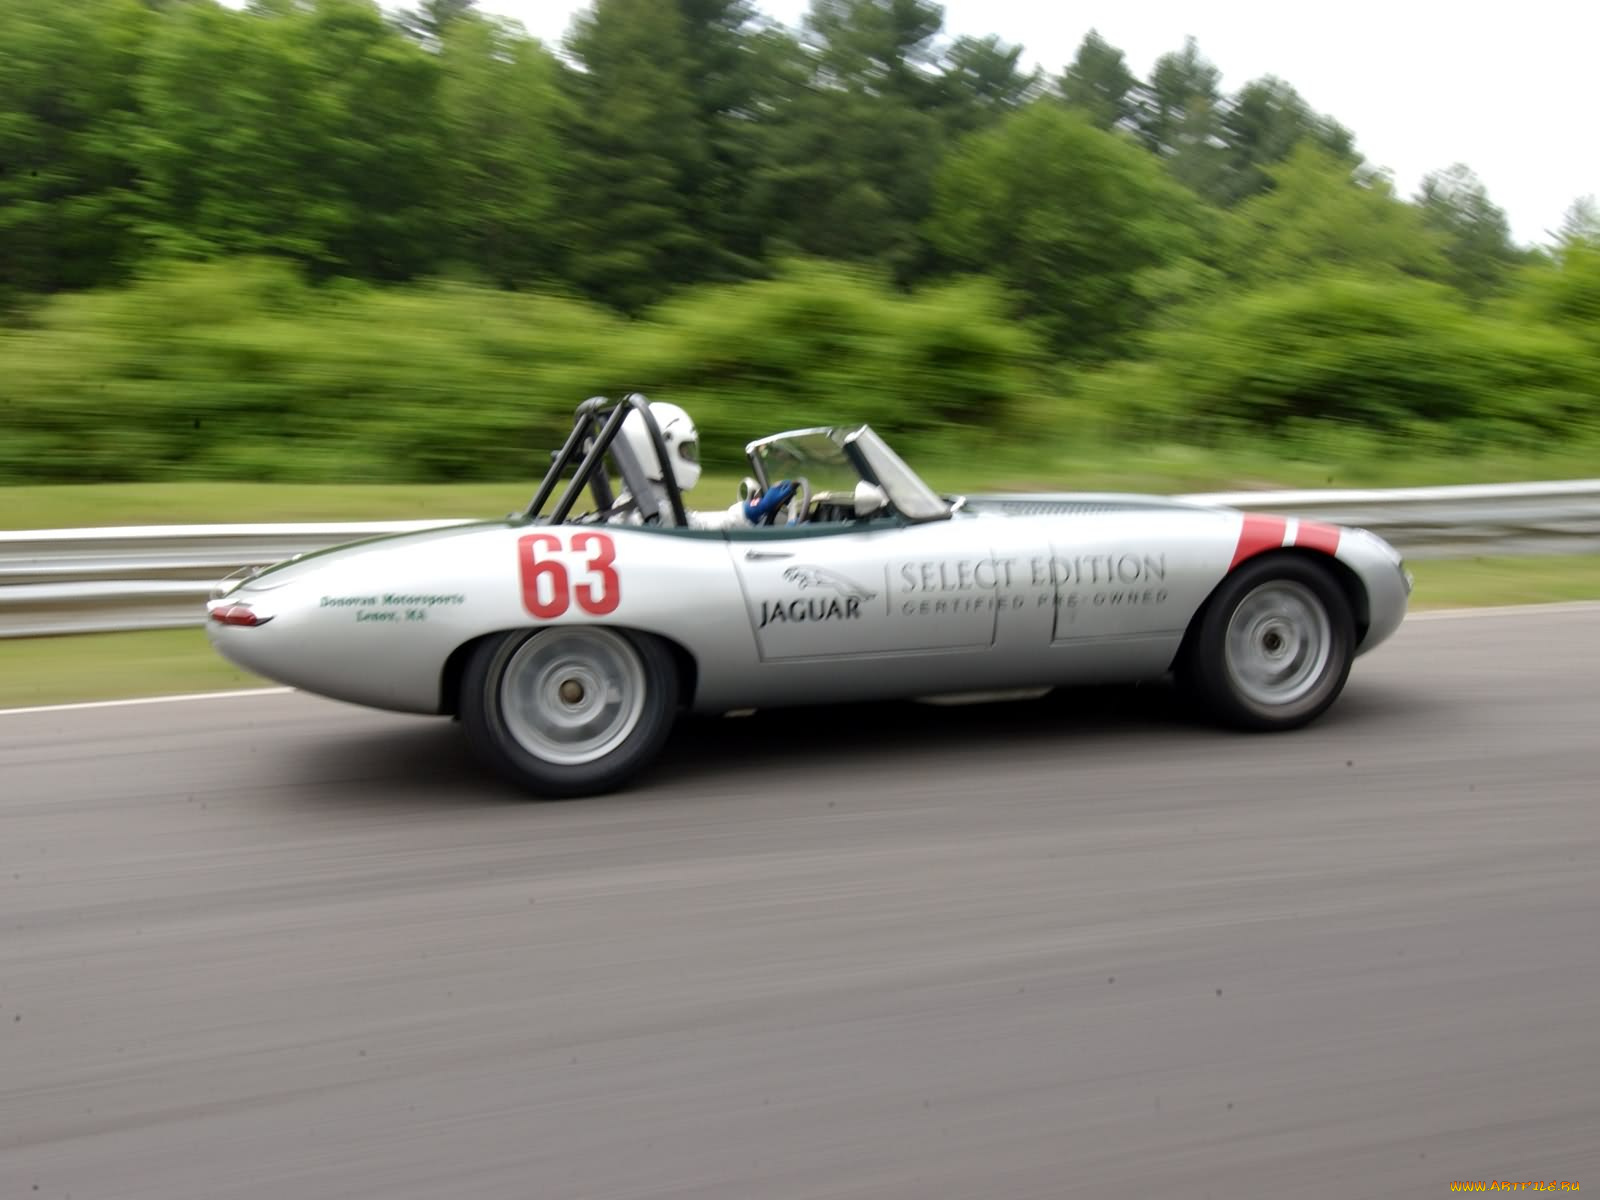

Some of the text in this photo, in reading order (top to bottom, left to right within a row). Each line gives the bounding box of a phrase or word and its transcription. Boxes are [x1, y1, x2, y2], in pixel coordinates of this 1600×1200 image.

[518, 532, 620, 619] 63
[901, 552, 1166, 593] SELECT EDITION
[319, 592, 465, 608] Donovan Motorsports
[760, 597, 861, 628] JAGUAR
[902, 594, 1025, 616] CERTIFIED
